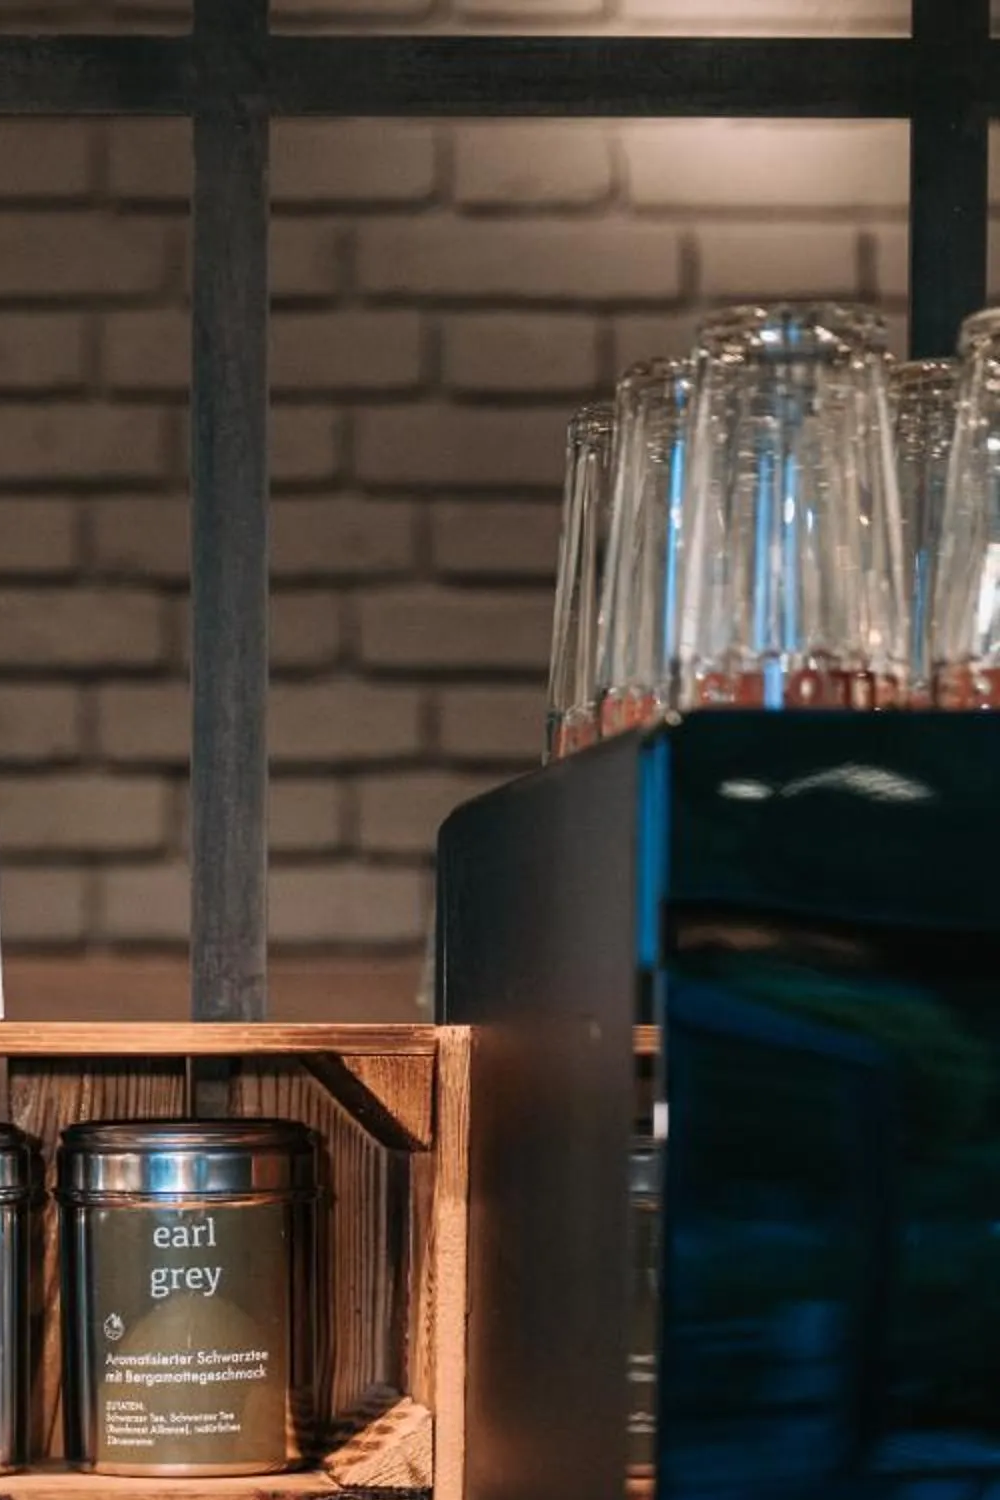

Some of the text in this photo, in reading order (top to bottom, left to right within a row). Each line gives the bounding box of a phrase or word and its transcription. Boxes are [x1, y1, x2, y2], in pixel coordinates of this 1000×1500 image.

[153, 1217, 216, 1248] earl
[150, 1266, 221, 1298] grey
[106, 1350, 268, 1366] Aromatisierter Schwarztee
[106, 1364, 266, 1386] mit Bergamottegeschmack
